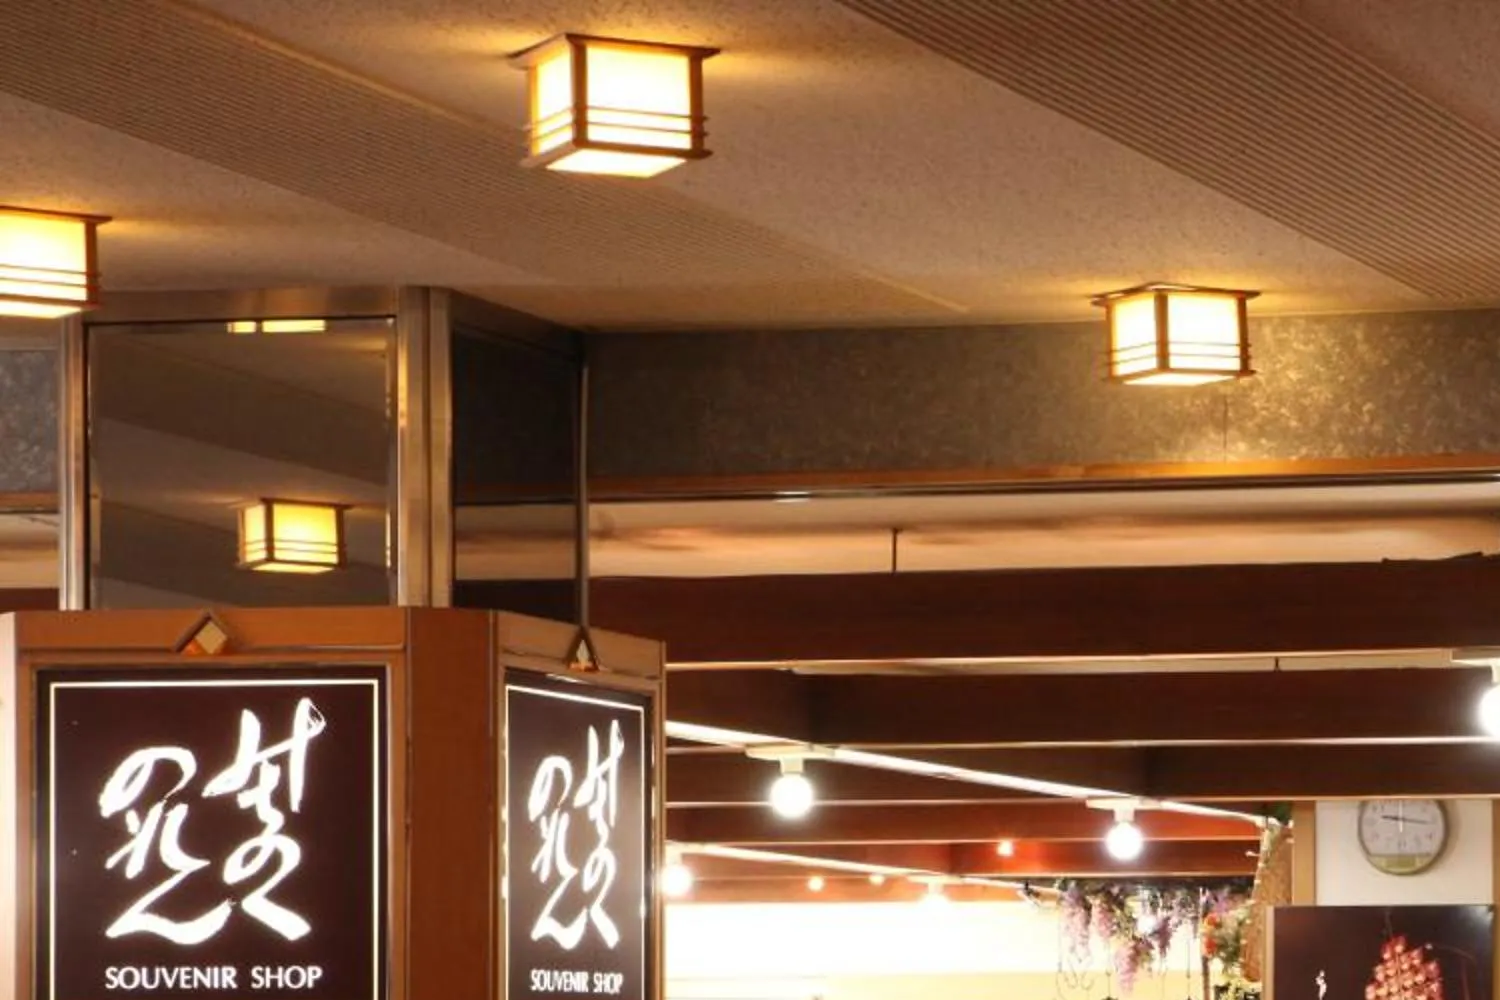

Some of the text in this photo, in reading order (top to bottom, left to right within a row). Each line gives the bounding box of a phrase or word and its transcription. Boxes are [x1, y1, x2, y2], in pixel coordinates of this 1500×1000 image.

[105, 965, 323, 990] SOUVENIR SHOP
[530, 968, 624, 994] SOUVENIR SHOP
